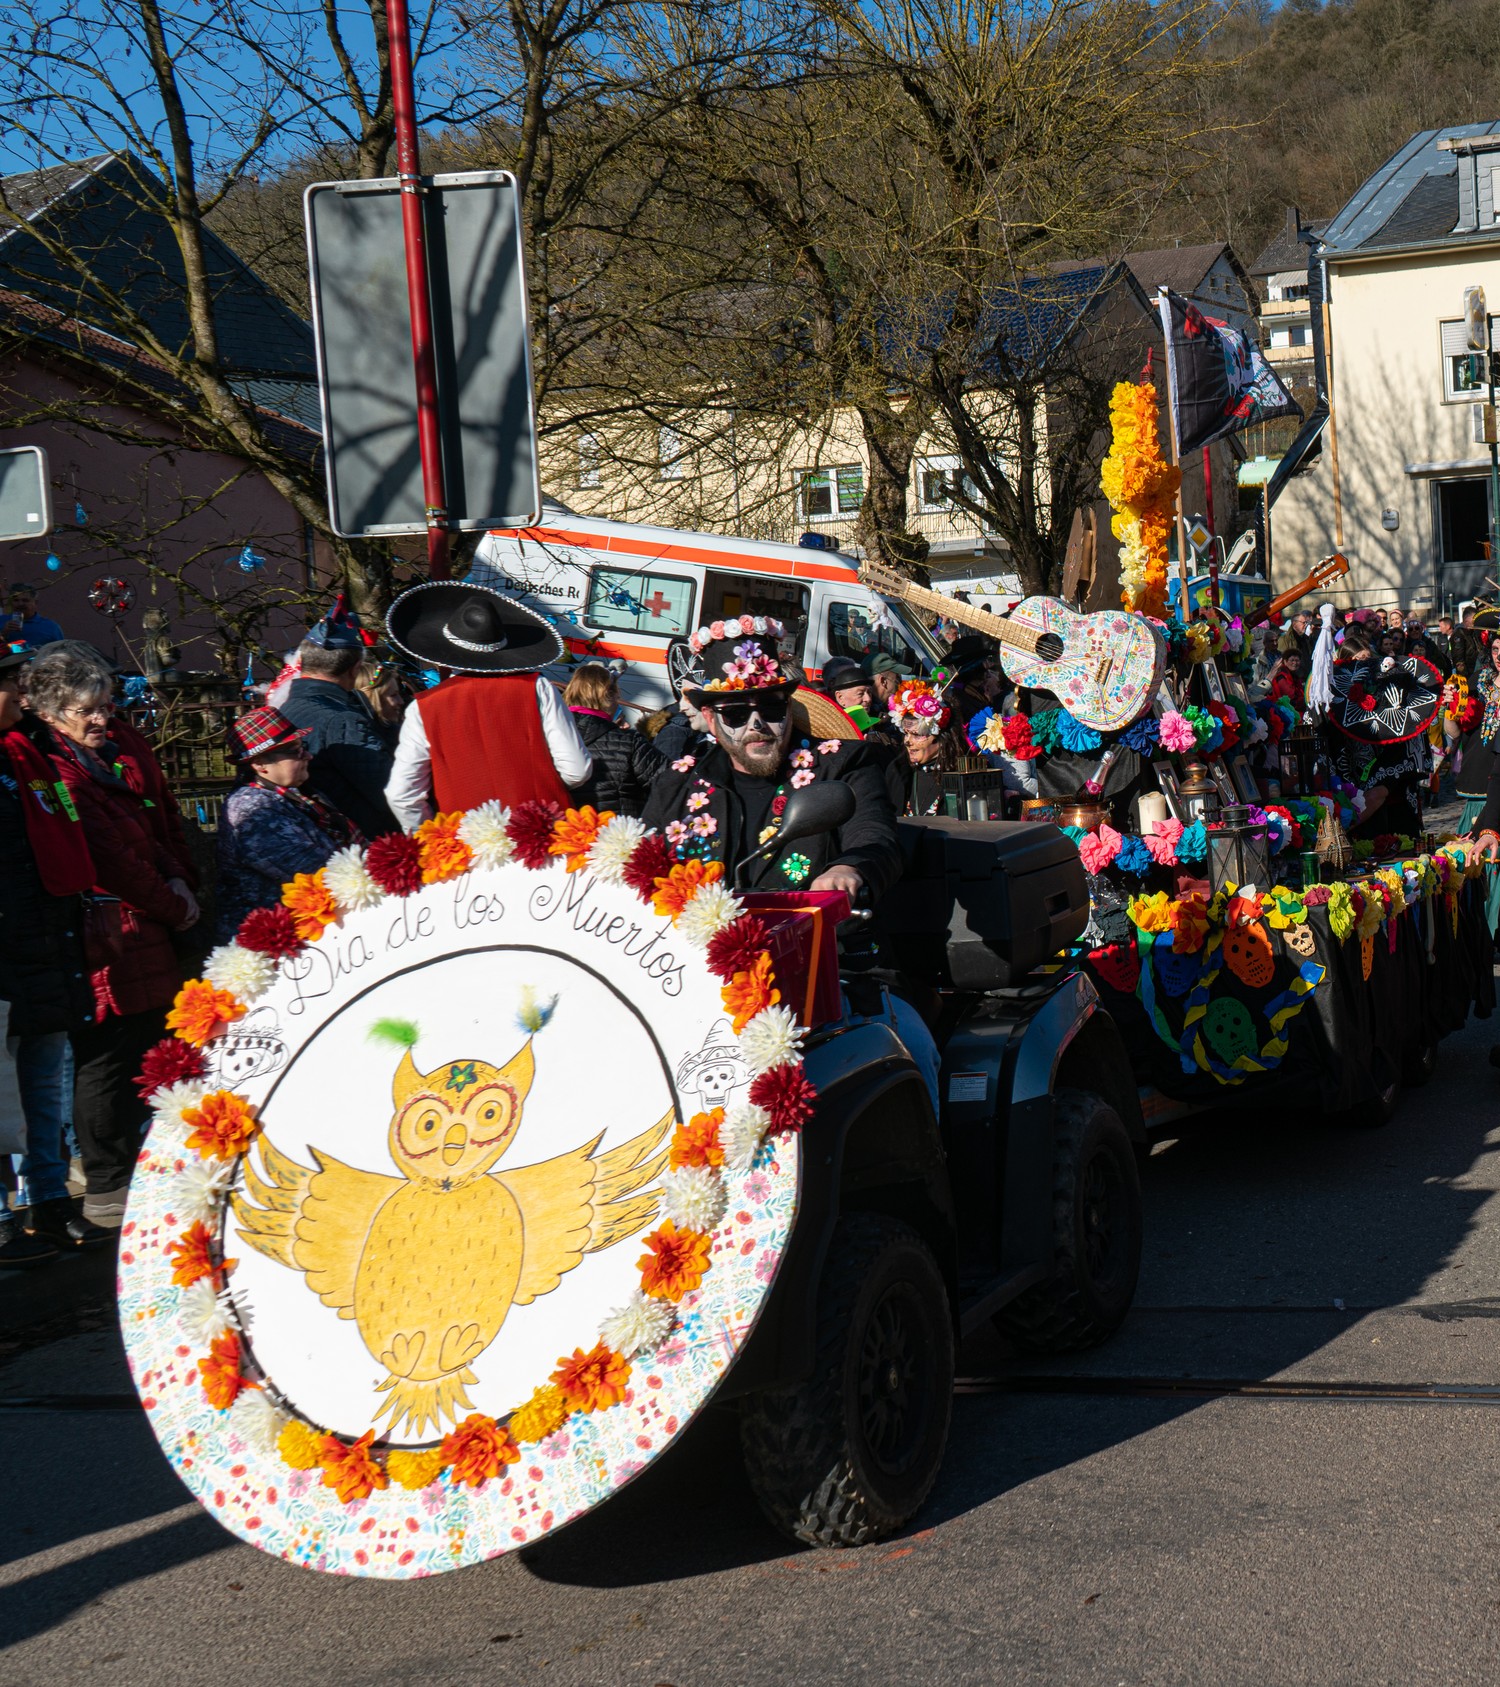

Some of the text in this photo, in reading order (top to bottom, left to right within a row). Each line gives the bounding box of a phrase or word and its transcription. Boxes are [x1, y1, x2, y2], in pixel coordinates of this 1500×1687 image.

[505, 577, 564, 597] Deutsches
[386, 896, 435, 951] de
[454, 873, 505, 929] los
[529, 872, 686, 997] Muertos
